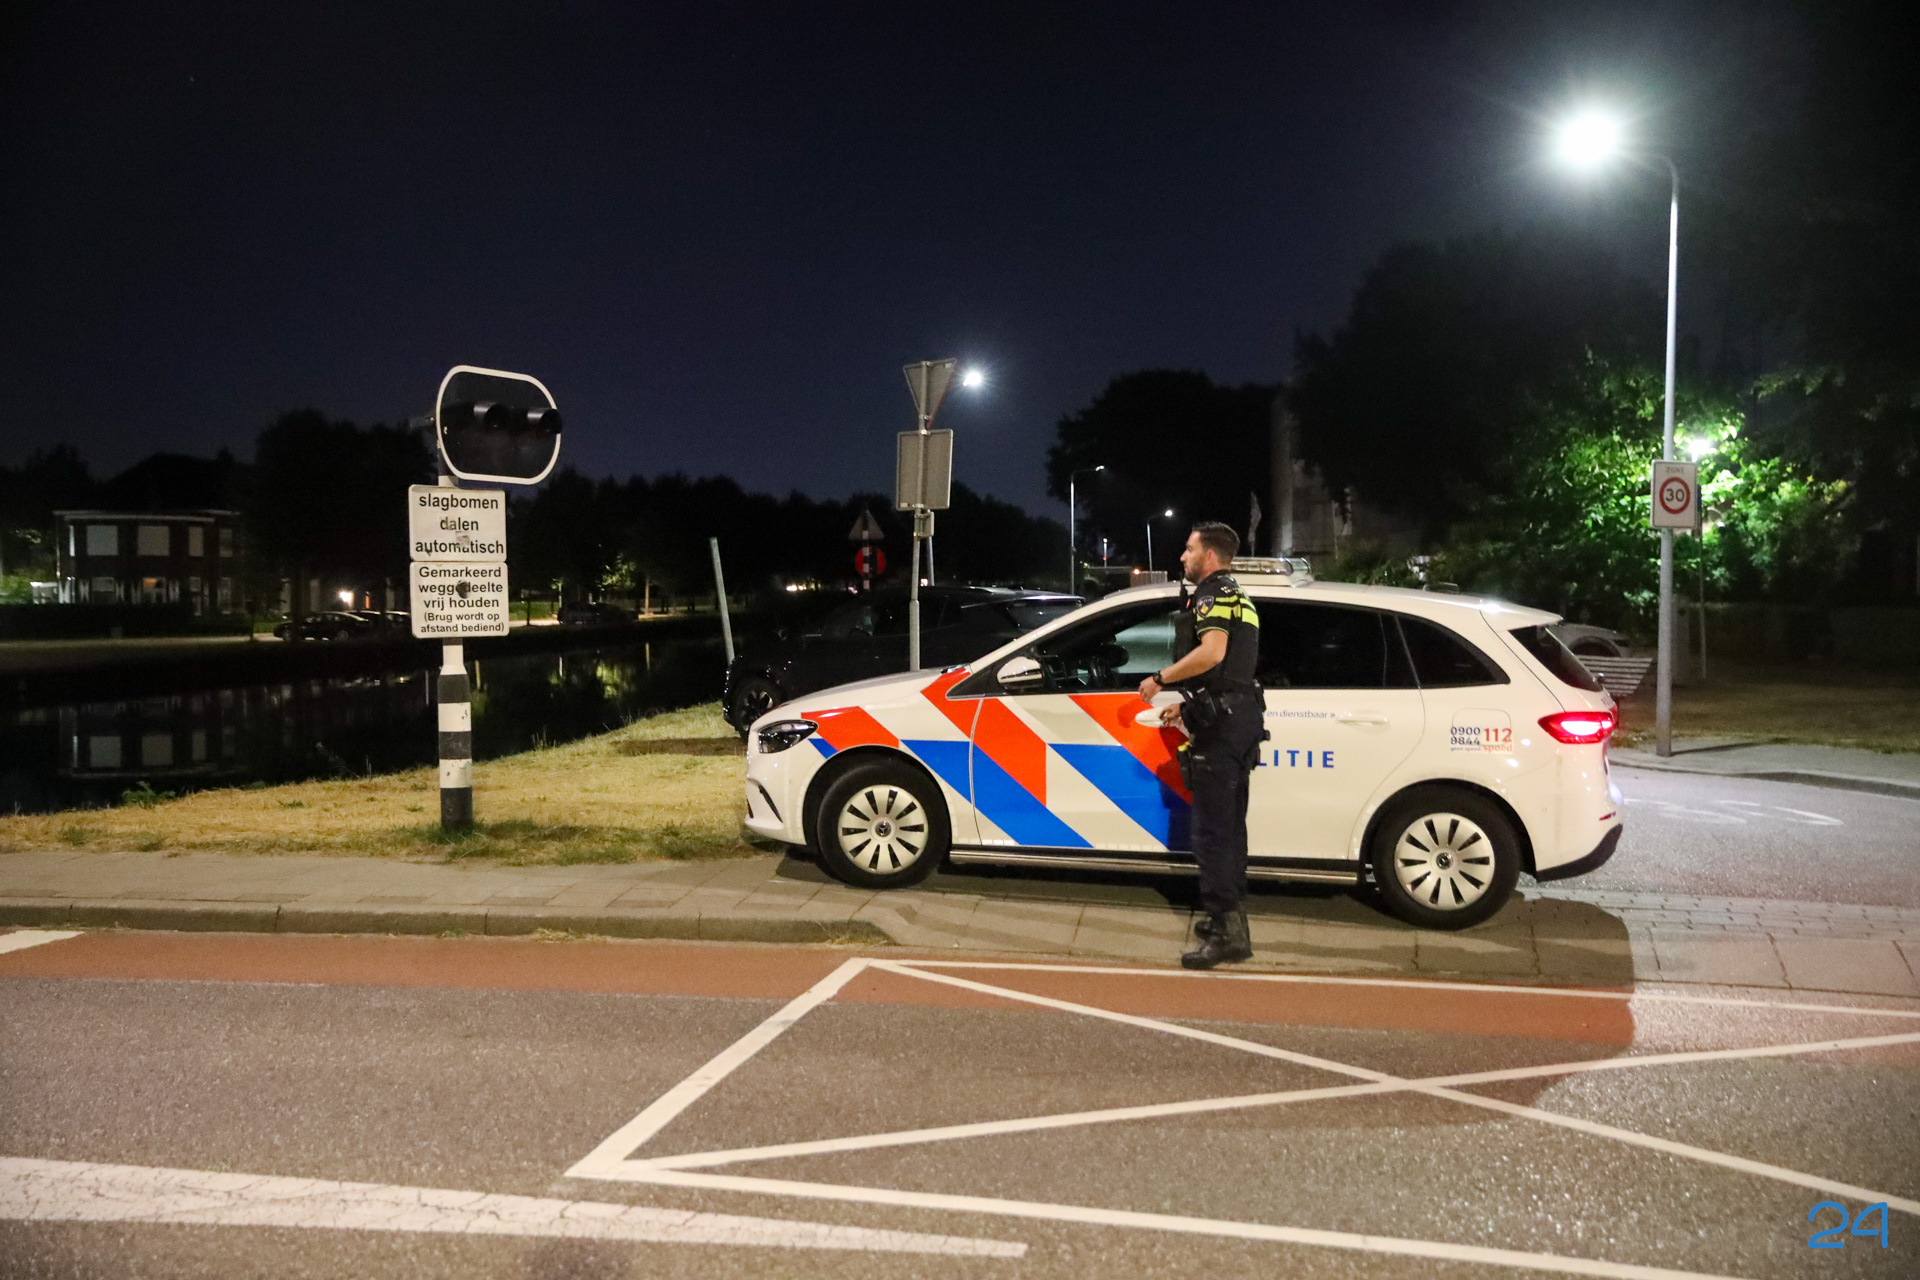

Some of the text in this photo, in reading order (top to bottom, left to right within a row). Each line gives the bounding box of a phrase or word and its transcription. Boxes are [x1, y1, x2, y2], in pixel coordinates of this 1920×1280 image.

[1665, 488, 1685, 502] 30
[419, 493, 499, 511] slagbomen
[440, 517, 479, 531] dalen
[419, 566, 501, 578] Gemarkeerd
[423, 597, 500, 611] vrij houden
[424, 612, 500, 623] (Brug wordt op
[421, 622, 504, 633] afstand bediend)
[1280, 709, 1328, 718] dienstbaar
[1450, 726, 1480, 736] 0900
[1483, 728, 1512, 742] 112
[1483, 743, 1512, 754] spoed
